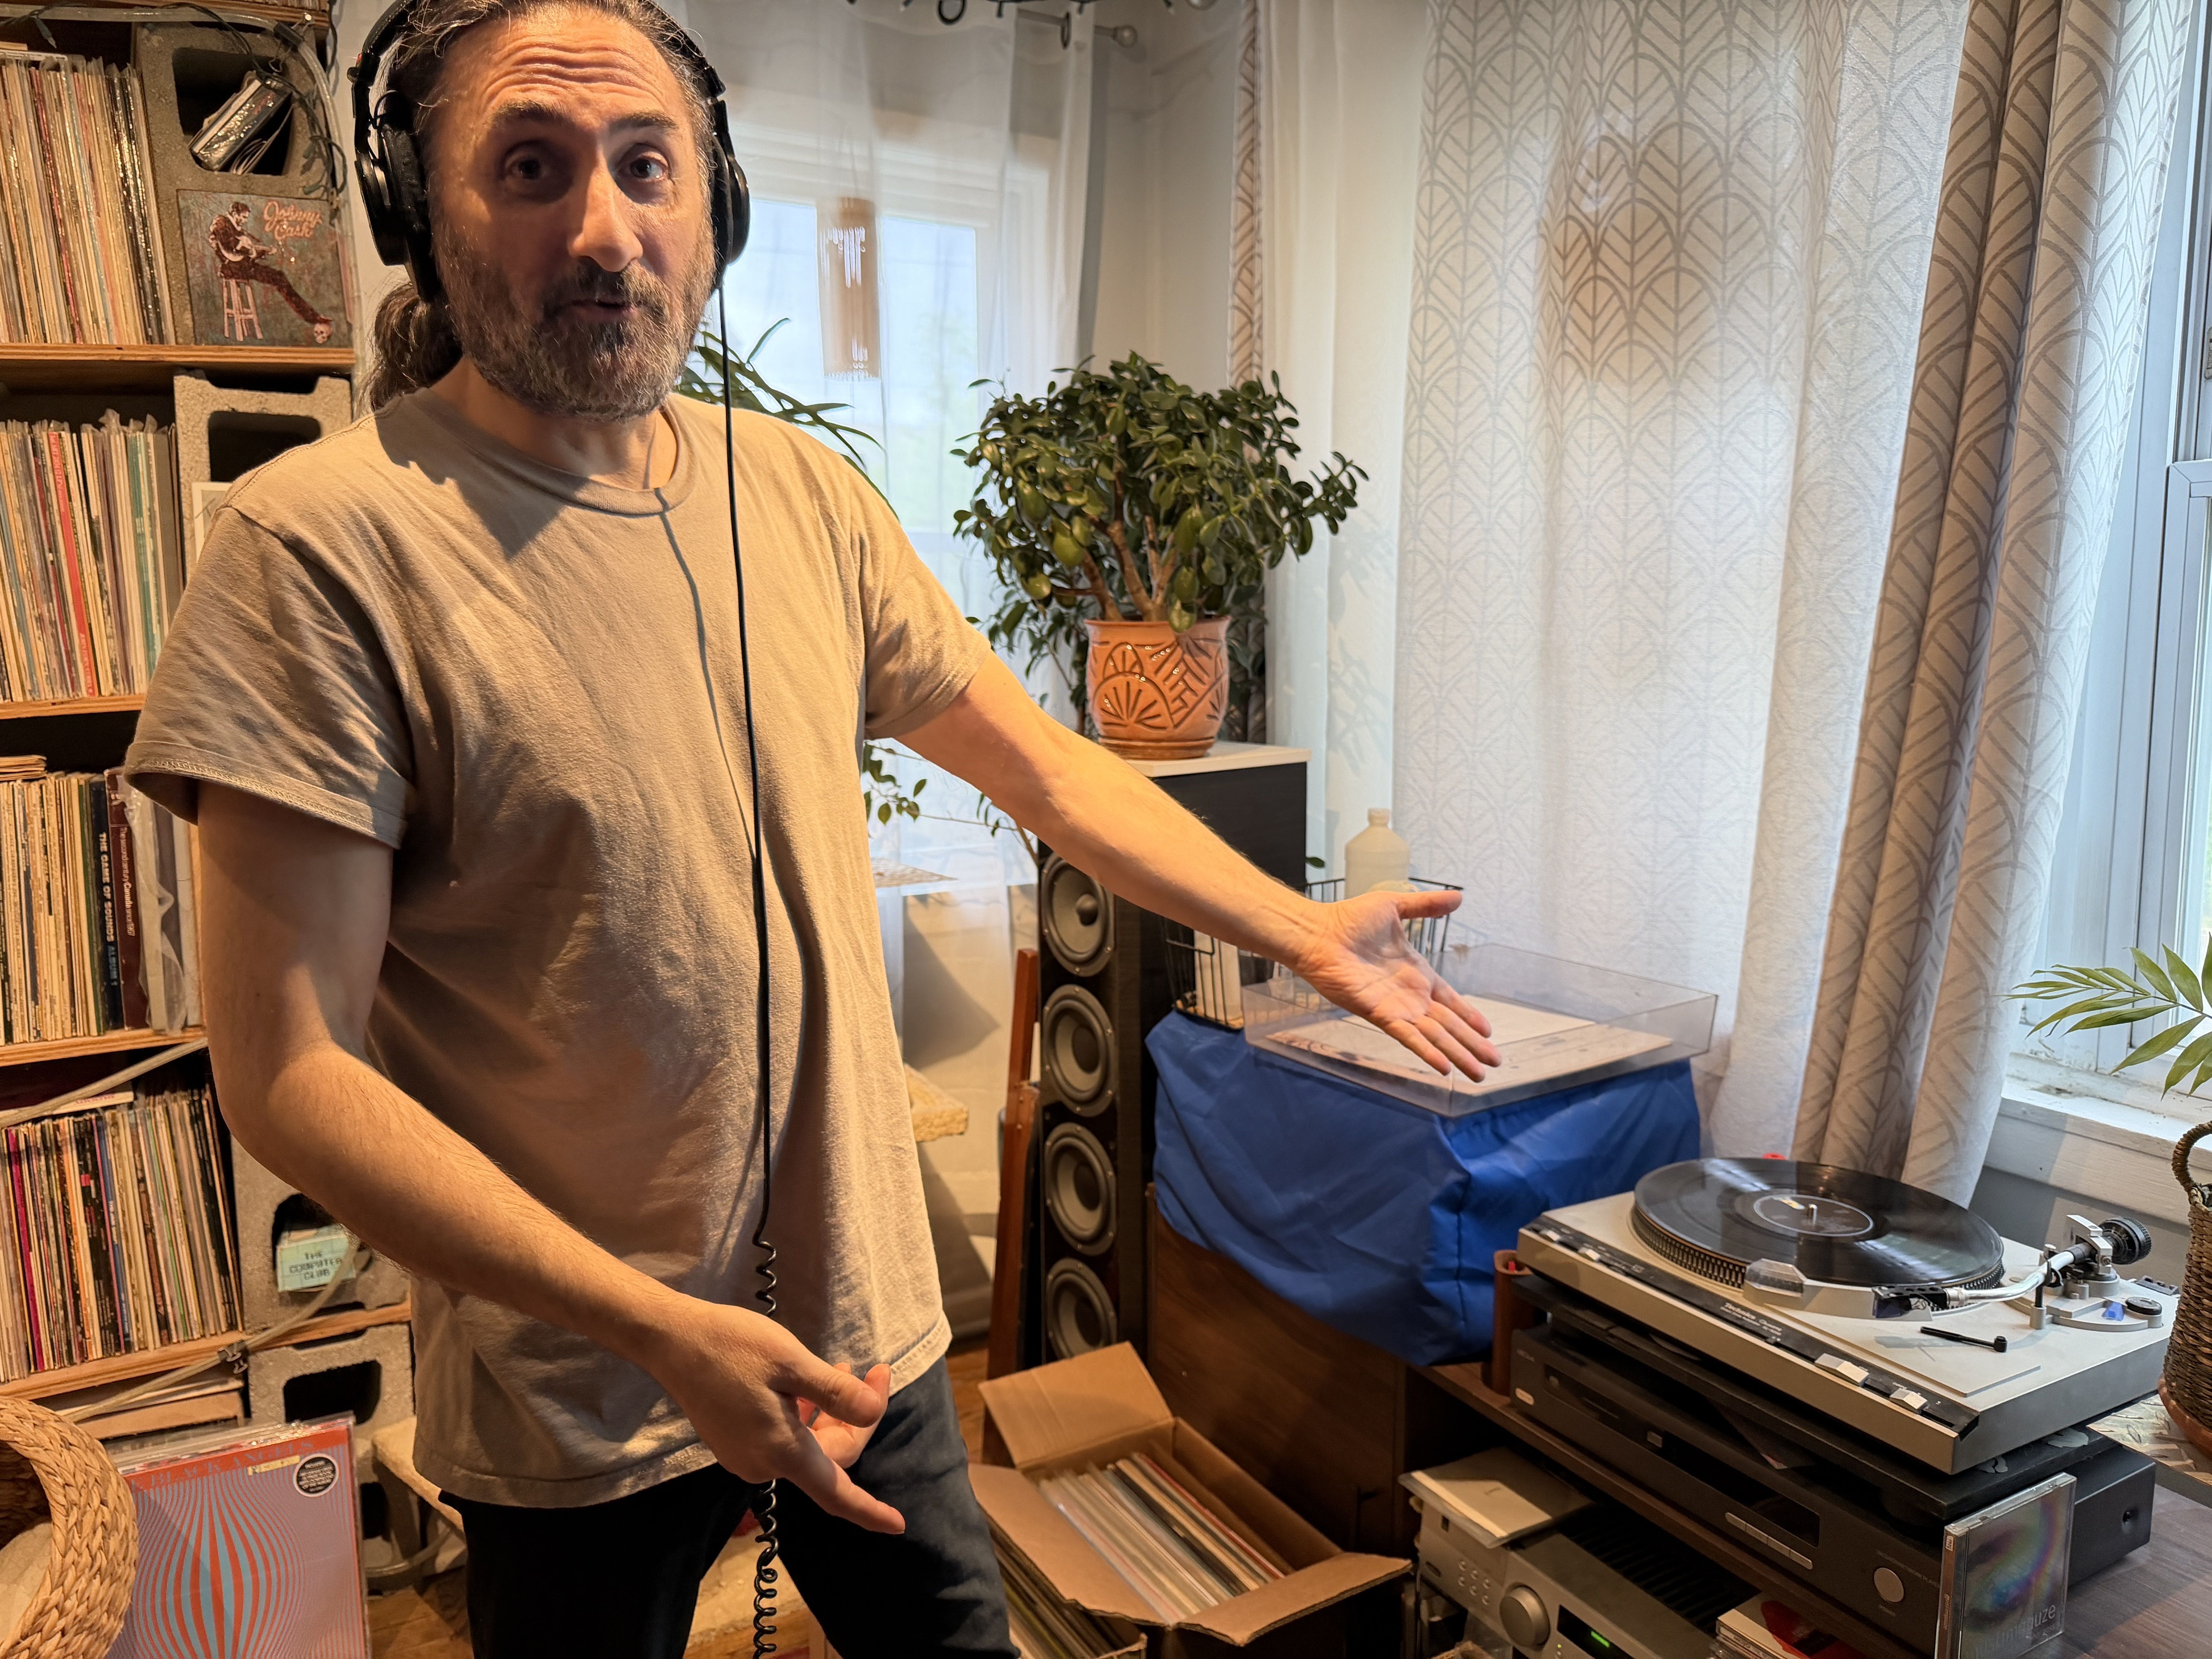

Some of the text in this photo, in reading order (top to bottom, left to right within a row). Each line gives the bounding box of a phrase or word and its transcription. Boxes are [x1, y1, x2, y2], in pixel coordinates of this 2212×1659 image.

[263, 201, 323, 232] Johnny
[275, 220, 313, 240] Cash
[100, 831, 108, 852] THE
[104, 885, 111, 899] OF
[124, 882, 133, 909] Canada
[105, 901, 115, 943] SOUNDS
[305, 1251, 323, 1260] THE
[290, 1258, 342, 1274] COMPUTER
[303, 1269, 330, 1280] CLUB
